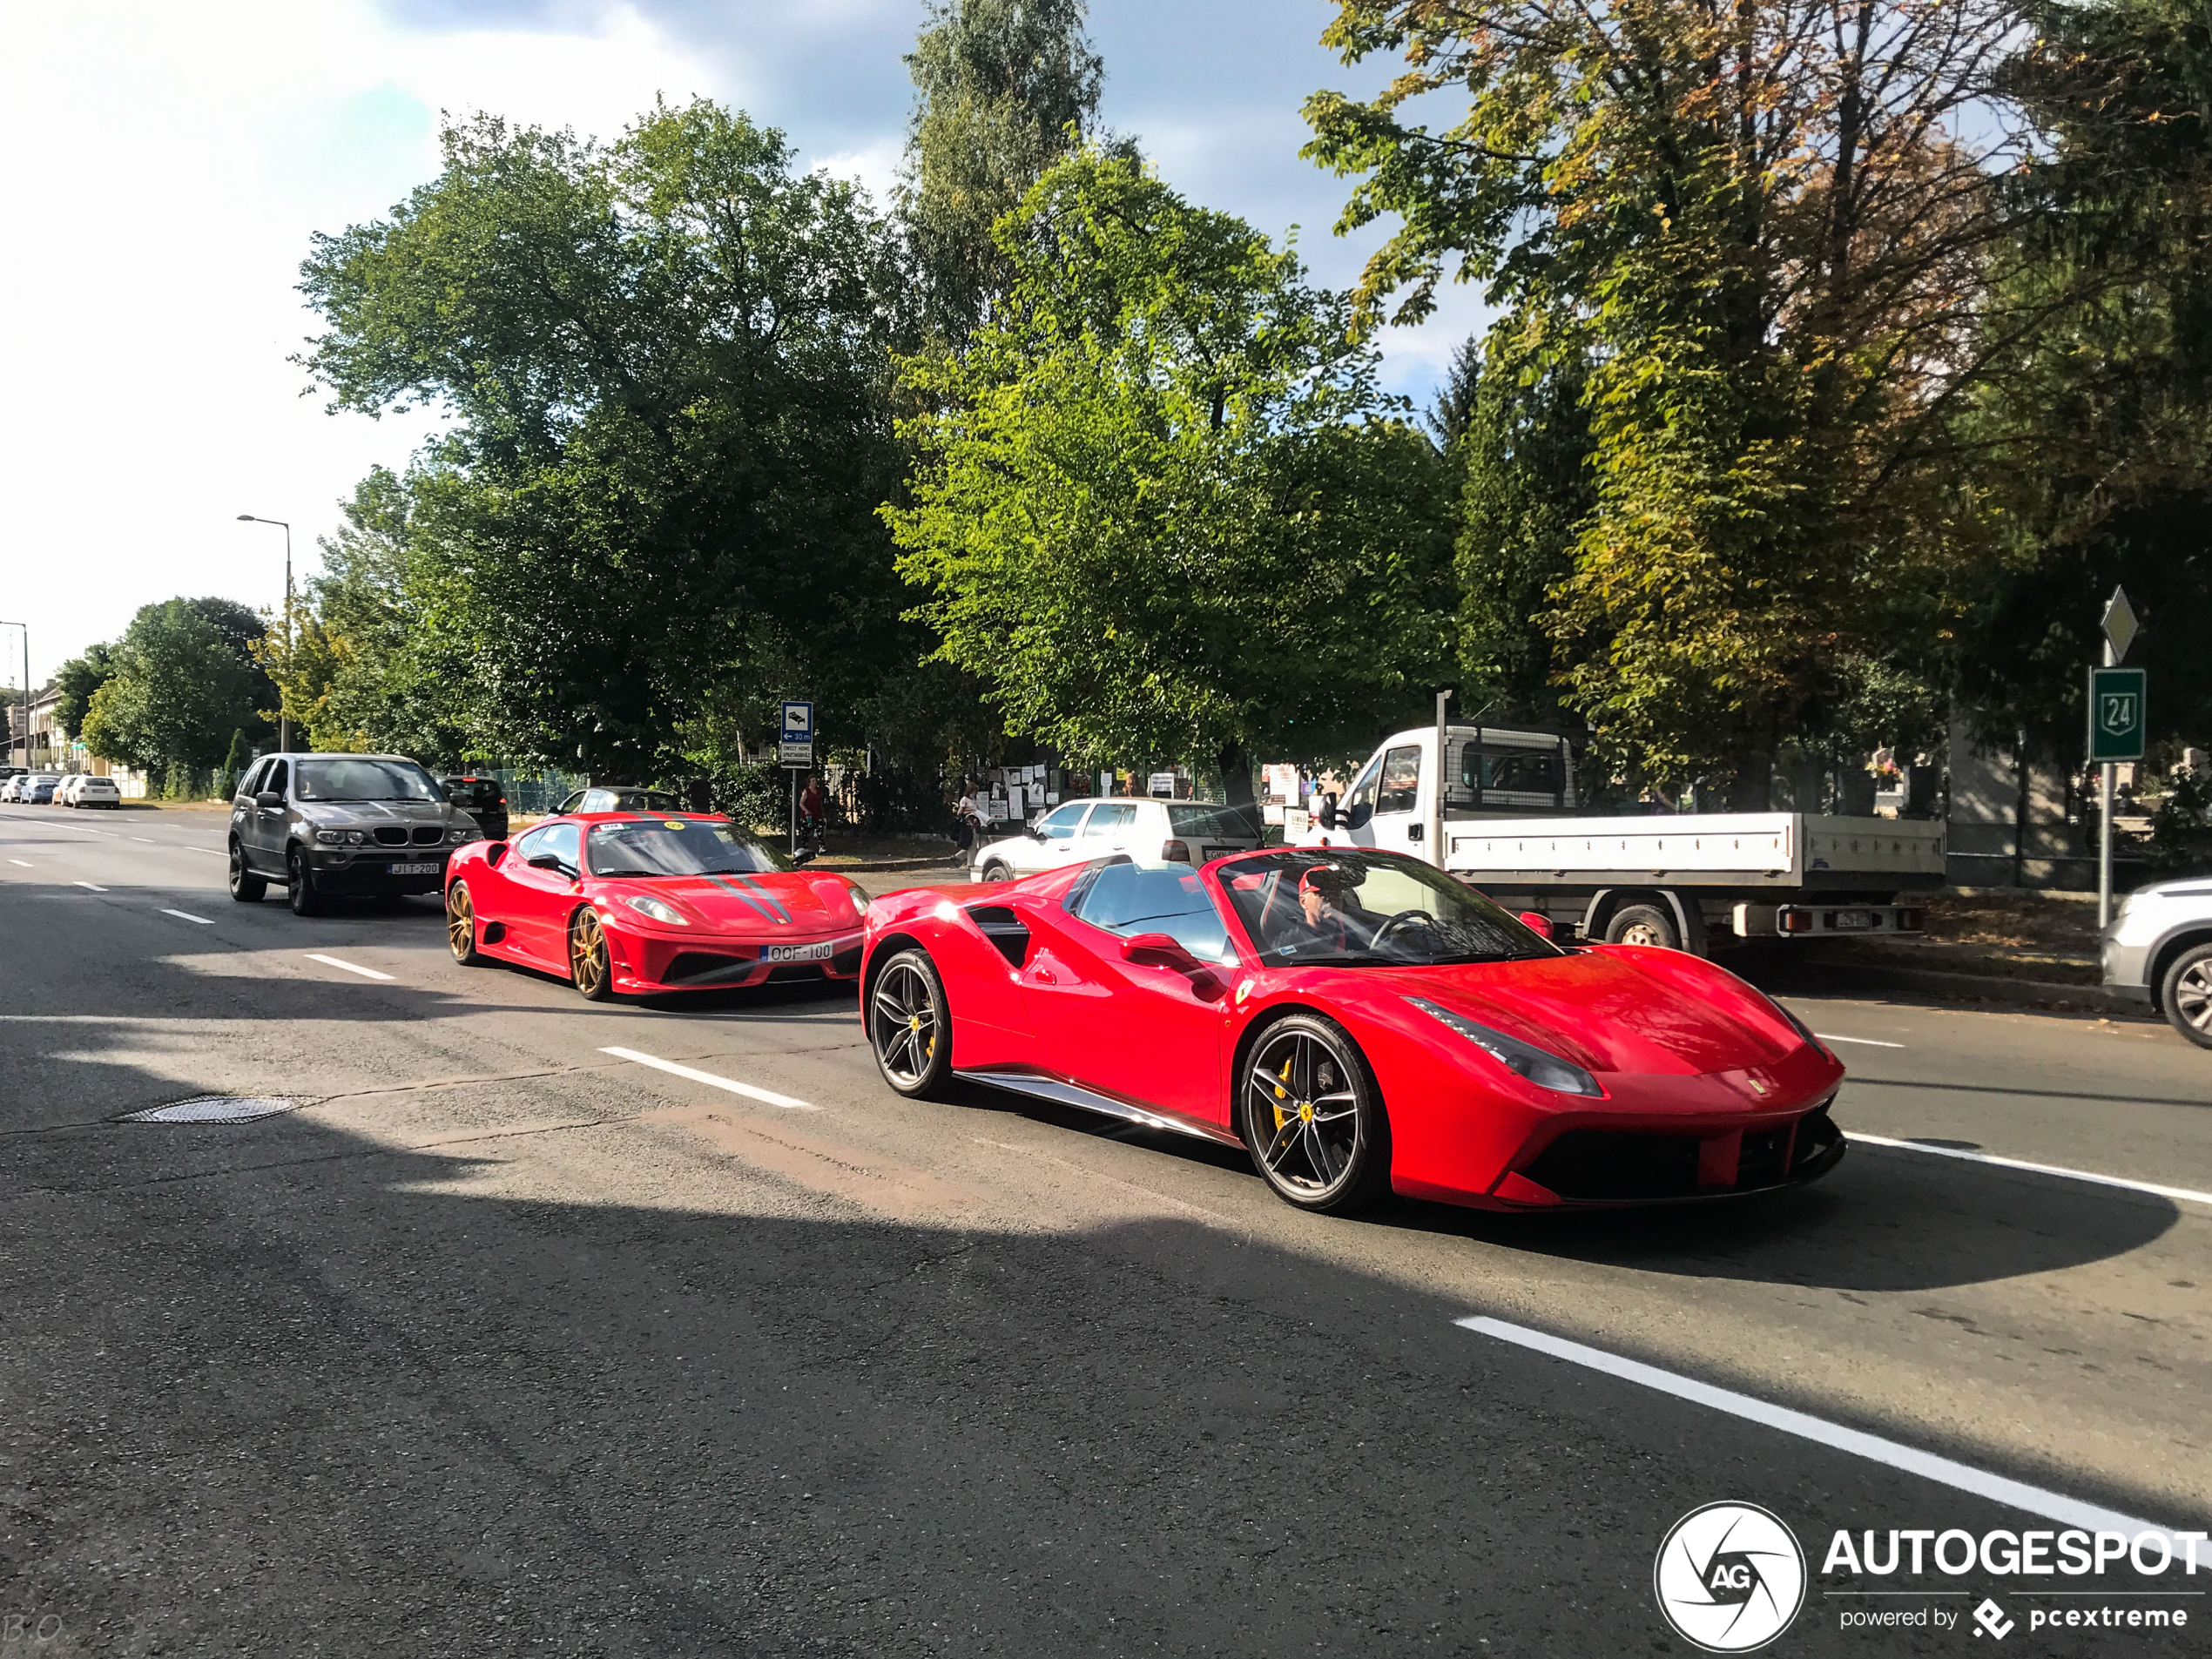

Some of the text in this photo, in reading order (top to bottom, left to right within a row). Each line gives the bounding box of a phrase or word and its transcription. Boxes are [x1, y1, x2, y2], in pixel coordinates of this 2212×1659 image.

[2107, 698, 2130, 726] 24
[394, 864, 437, 873] JIT-200
[771, 944, 831, 961] OOF-100
